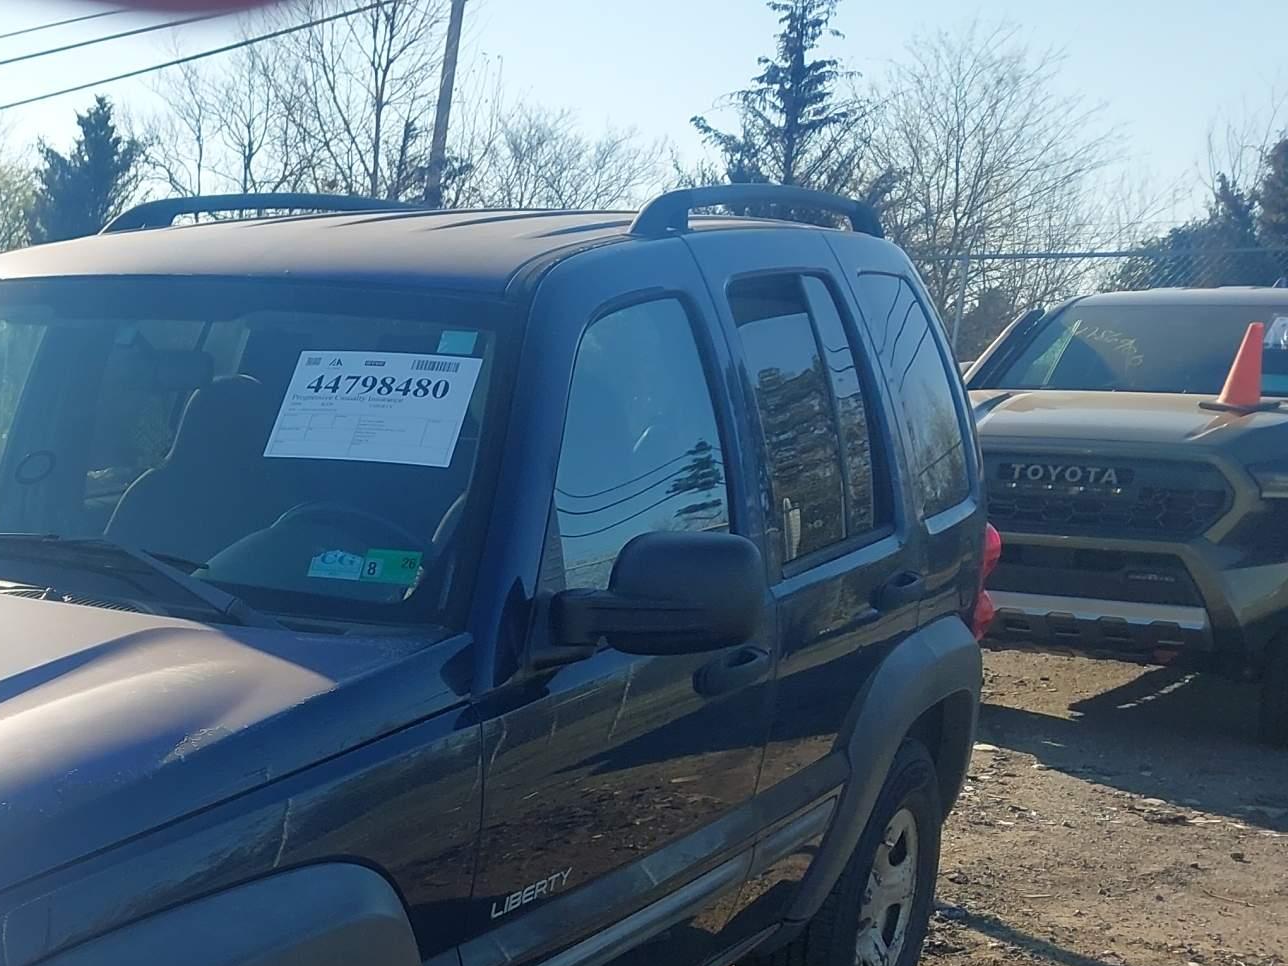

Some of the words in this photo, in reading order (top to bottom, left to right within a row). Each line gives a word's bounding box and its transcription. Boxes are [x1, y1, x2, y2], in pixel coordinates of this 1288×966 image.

[306, 374, 450, 400] 44798480
[1011, 463, 1118, 484] TOYOTA
[367, 561, 377, 576] 8
[491, 867, 572, 919] LIBERTY
